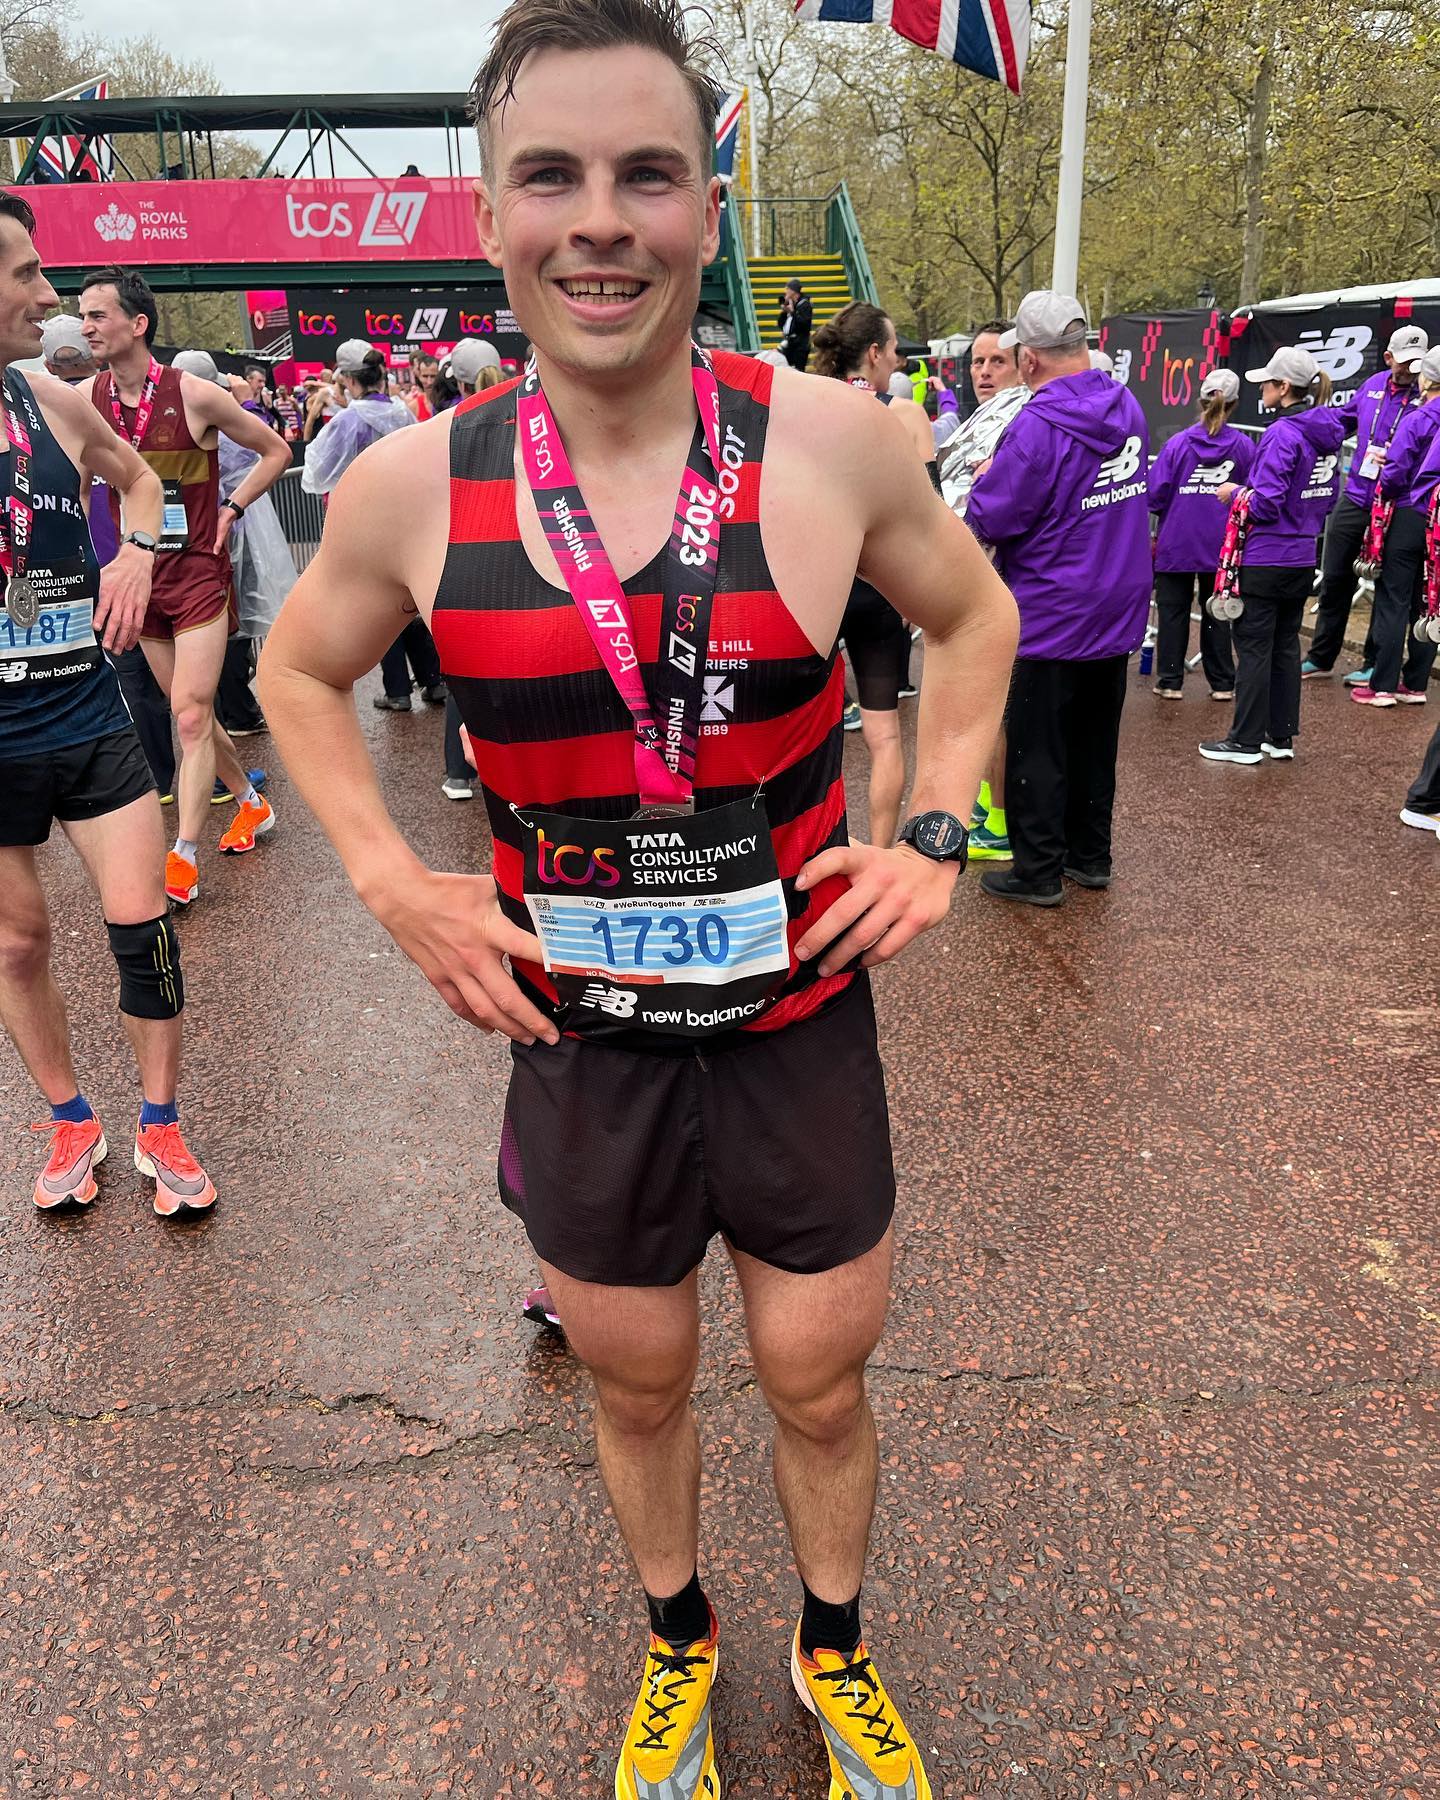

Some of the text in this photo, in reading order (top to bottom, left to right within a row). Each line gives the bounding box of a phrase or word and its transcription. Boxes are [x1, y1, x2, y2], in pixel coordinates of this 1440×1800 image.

[138, 201, 155, 209] THE
[285, 193, 353, 238] tcs
[139, 211, 188, 225] ROYAL
[142, 227, 188, 240] PARKS
[298, 310, 338, 336] tcs
[364, 308, 405, 336] tcs
[458, 310, 494, 334] tcs
[1161, 347, 1195, 406] tcs
[719, 424, 747, 519] soar
[1081, 481, 1147, 510] new balanc
[1179, 485, 1198, 494] new
[14, 506, 28, 546] 2023
[552, 495, 593, 573] FINISHER
[678, 485, 718, 567] 2023
[26, 568, 53, 578] TATA
[29, 574, 85, 588] ONSULTANCY
[35, 587, 67, 598] RVICES
[675, 593, 702, 632] tcs
[722, 640, 754, 653] HILL
[30, 669, 52, 680] new
[53, 662, 92, 677] balance
[705, 658, 749, 670] RIERS
[625, 832, 686, 849] TATA
[629, 834, 757, 867] CONSULTANCY
[536, 828, 621, 887] tcs
[632, 867, 718, 885] SERVICES
[613, 900, 686, 909] #WeRunTogether
[591, 913, 730, 966] 1730
[642, 1009, 683, 1024] new
[686, 998, 766, 1027] balance
